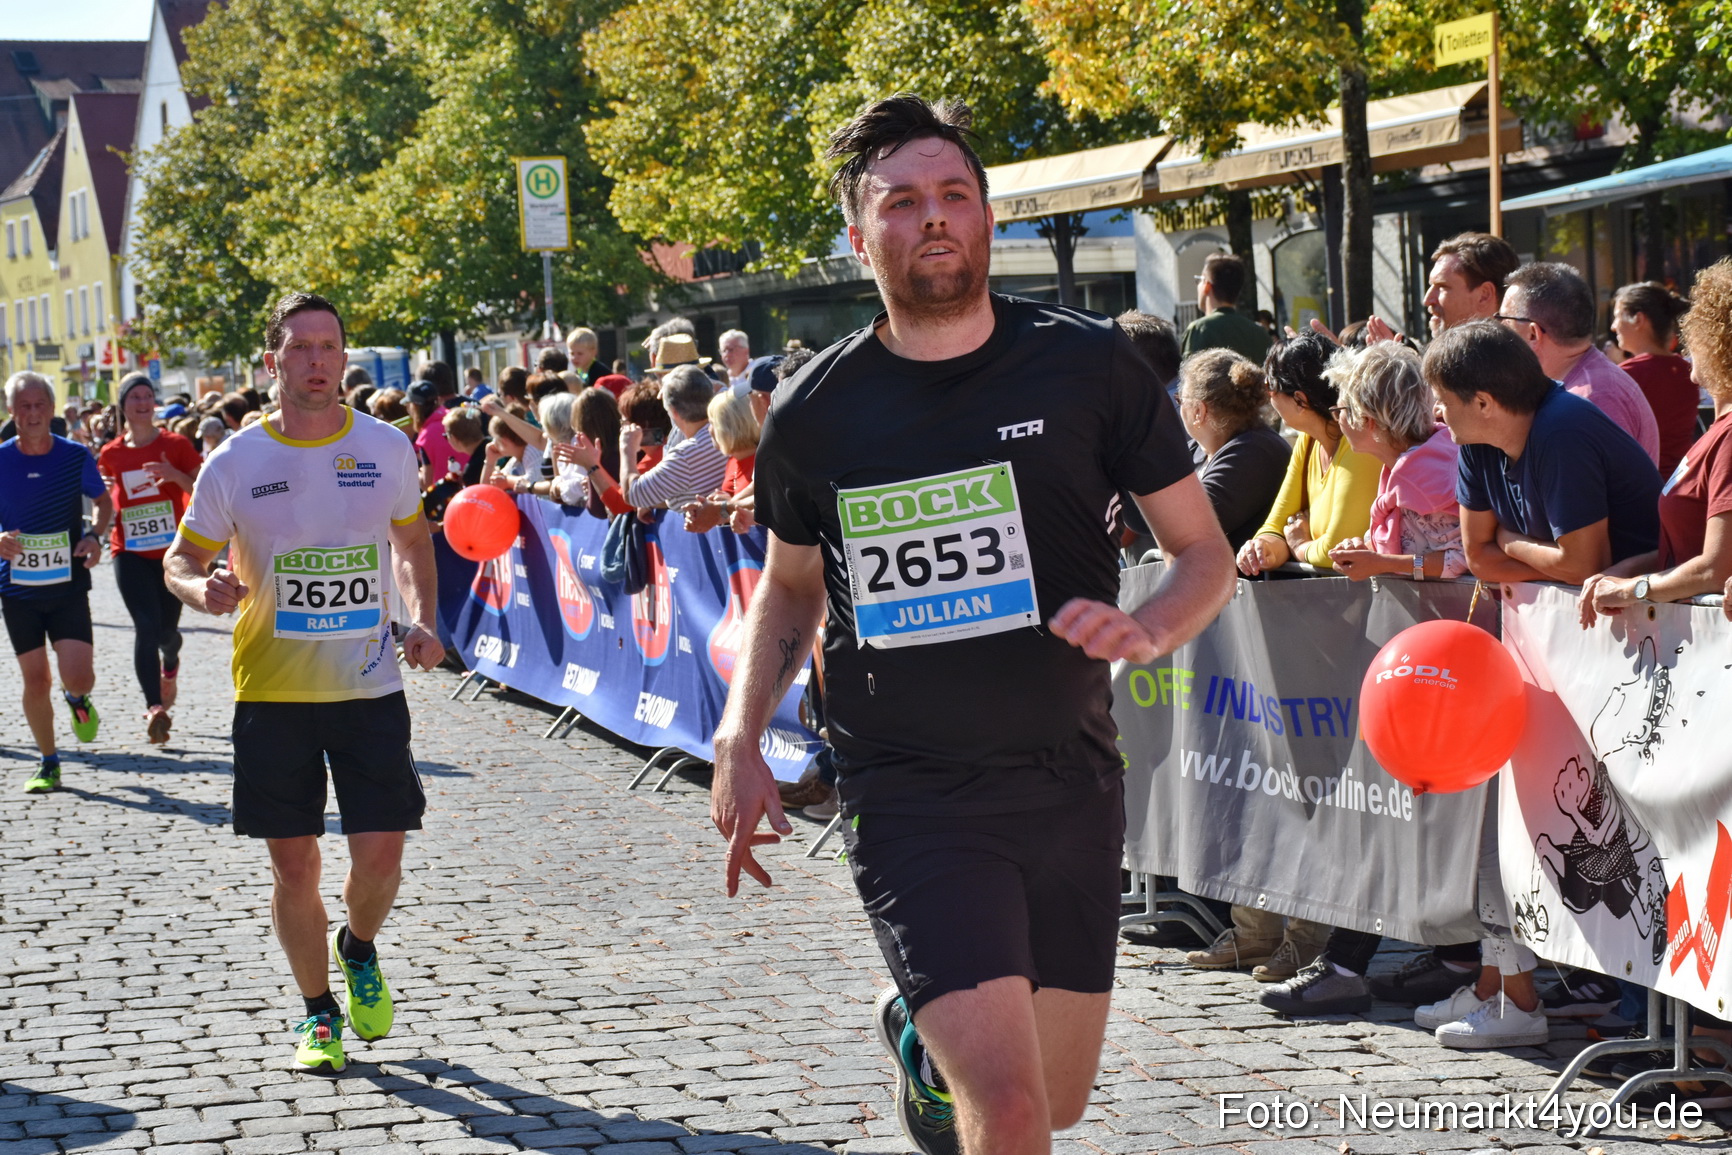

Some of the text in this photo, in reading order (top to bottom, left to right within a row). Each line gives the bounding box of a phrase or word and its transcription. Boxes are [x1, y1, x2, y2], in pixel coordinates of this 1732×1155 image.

[1446, 30, 1489, 51] Toiletten
[997, 419, 1044, 441] TCA
[336, 458, 356, 470] 20
[252, 481, 290, 496] BOCK
[338, 480, 375, 488] Stadtlauf
[126, 504, 168, 519] BOCK
[846, 475, 1001, 531] BOCK
[129, 518, 168, 536] 2581
[17, 551, 63, 568] 2814
[281, 548, 371, 572] BOCK
[861, 527, 1006, 593] 2653
[1007, 527, 1016, 536] D
[286, 577, 369, 609] 2620
[892, 593, 993, 628] JULIAN
[306, 615, 347, 630] RALF
[1414, 677, 1456, 690] energie
